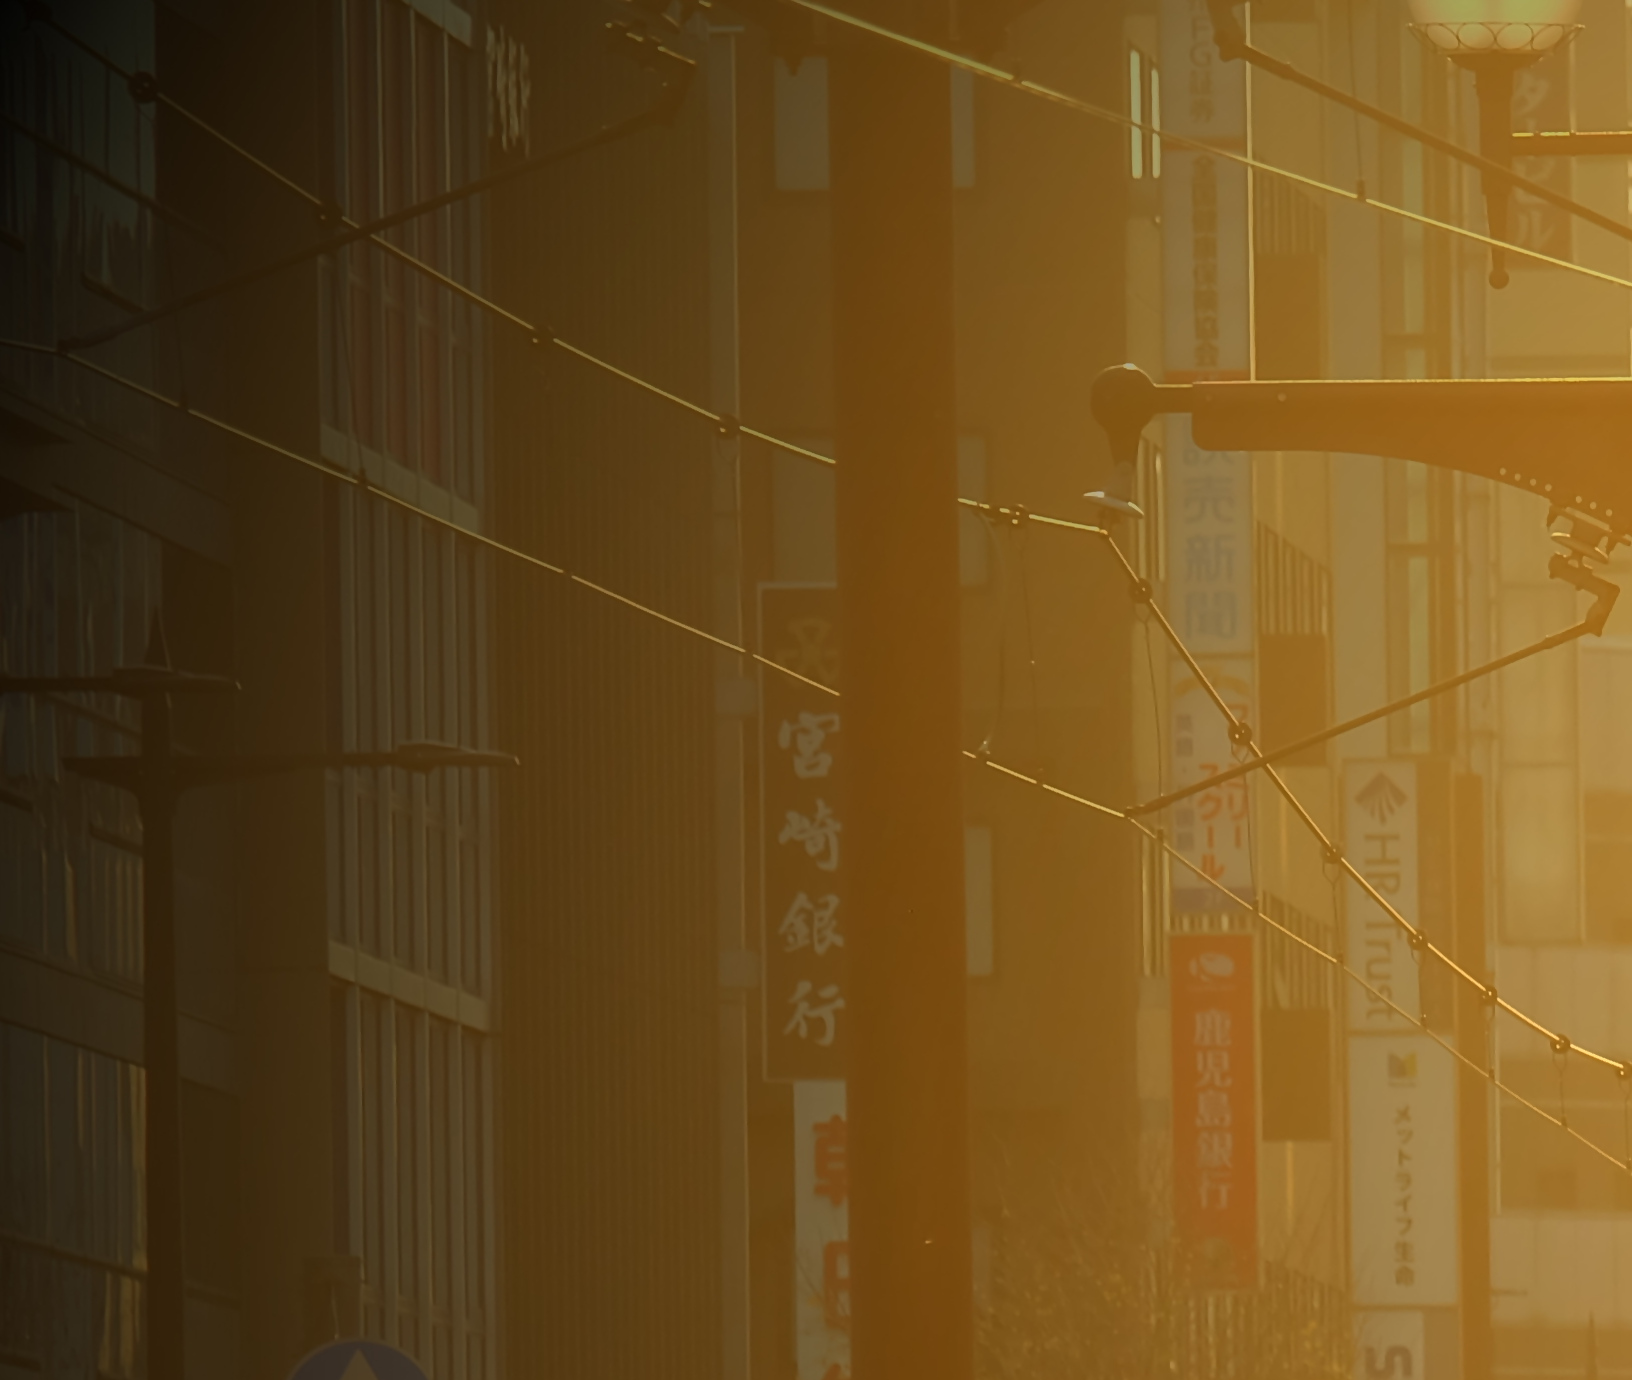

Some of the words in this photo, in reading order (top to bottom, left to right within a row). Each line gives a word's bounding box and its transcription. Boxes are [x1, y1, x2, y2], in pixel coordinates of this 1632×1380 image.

[778, 711, 847, 1048] 宮崎銀行
[1195, 1008, 1233, 1210] 鹿児島銀行
[1392, 1103, 1416, 1287] メットライフ生命
